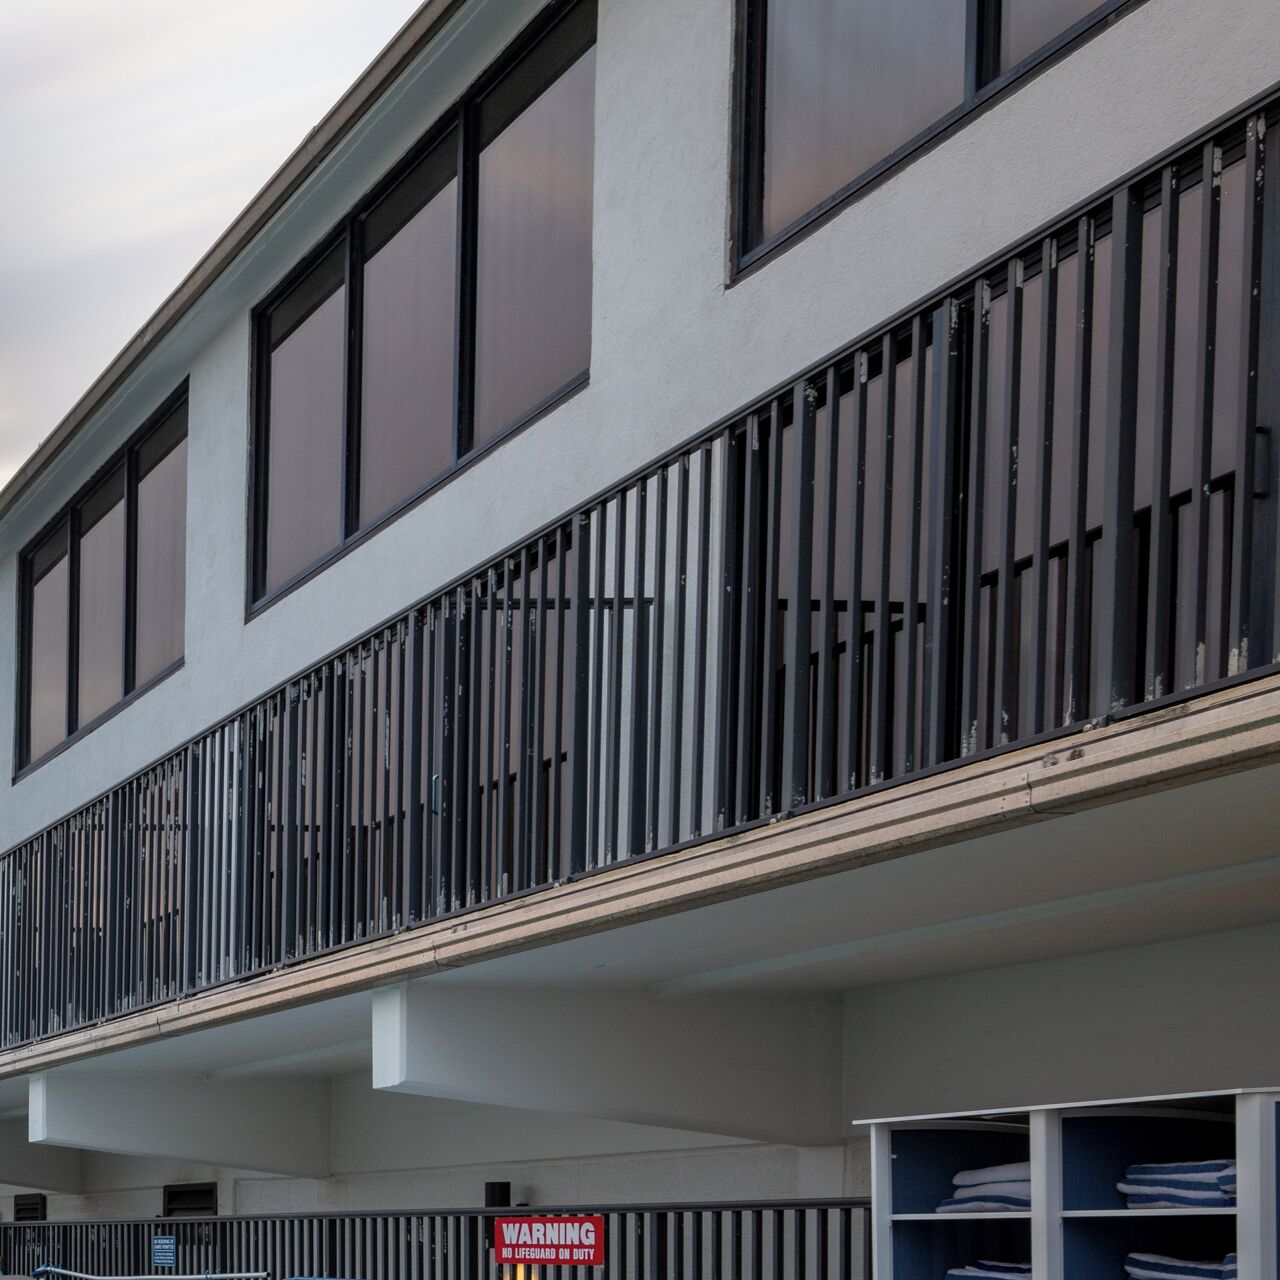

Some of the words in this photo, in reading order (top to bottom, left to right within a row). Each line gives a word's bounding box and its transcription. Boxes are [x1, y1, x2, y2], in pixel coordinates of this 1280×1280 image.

[502, 1222, 596, 1246] WARNING
[502, 1247, 512, 1259] NO
[515, 1247, 556, 1260] LIFEGUARD
[559, 1248, 570, 1260] ON
[573, 1248, 595, 1260] DUTY
